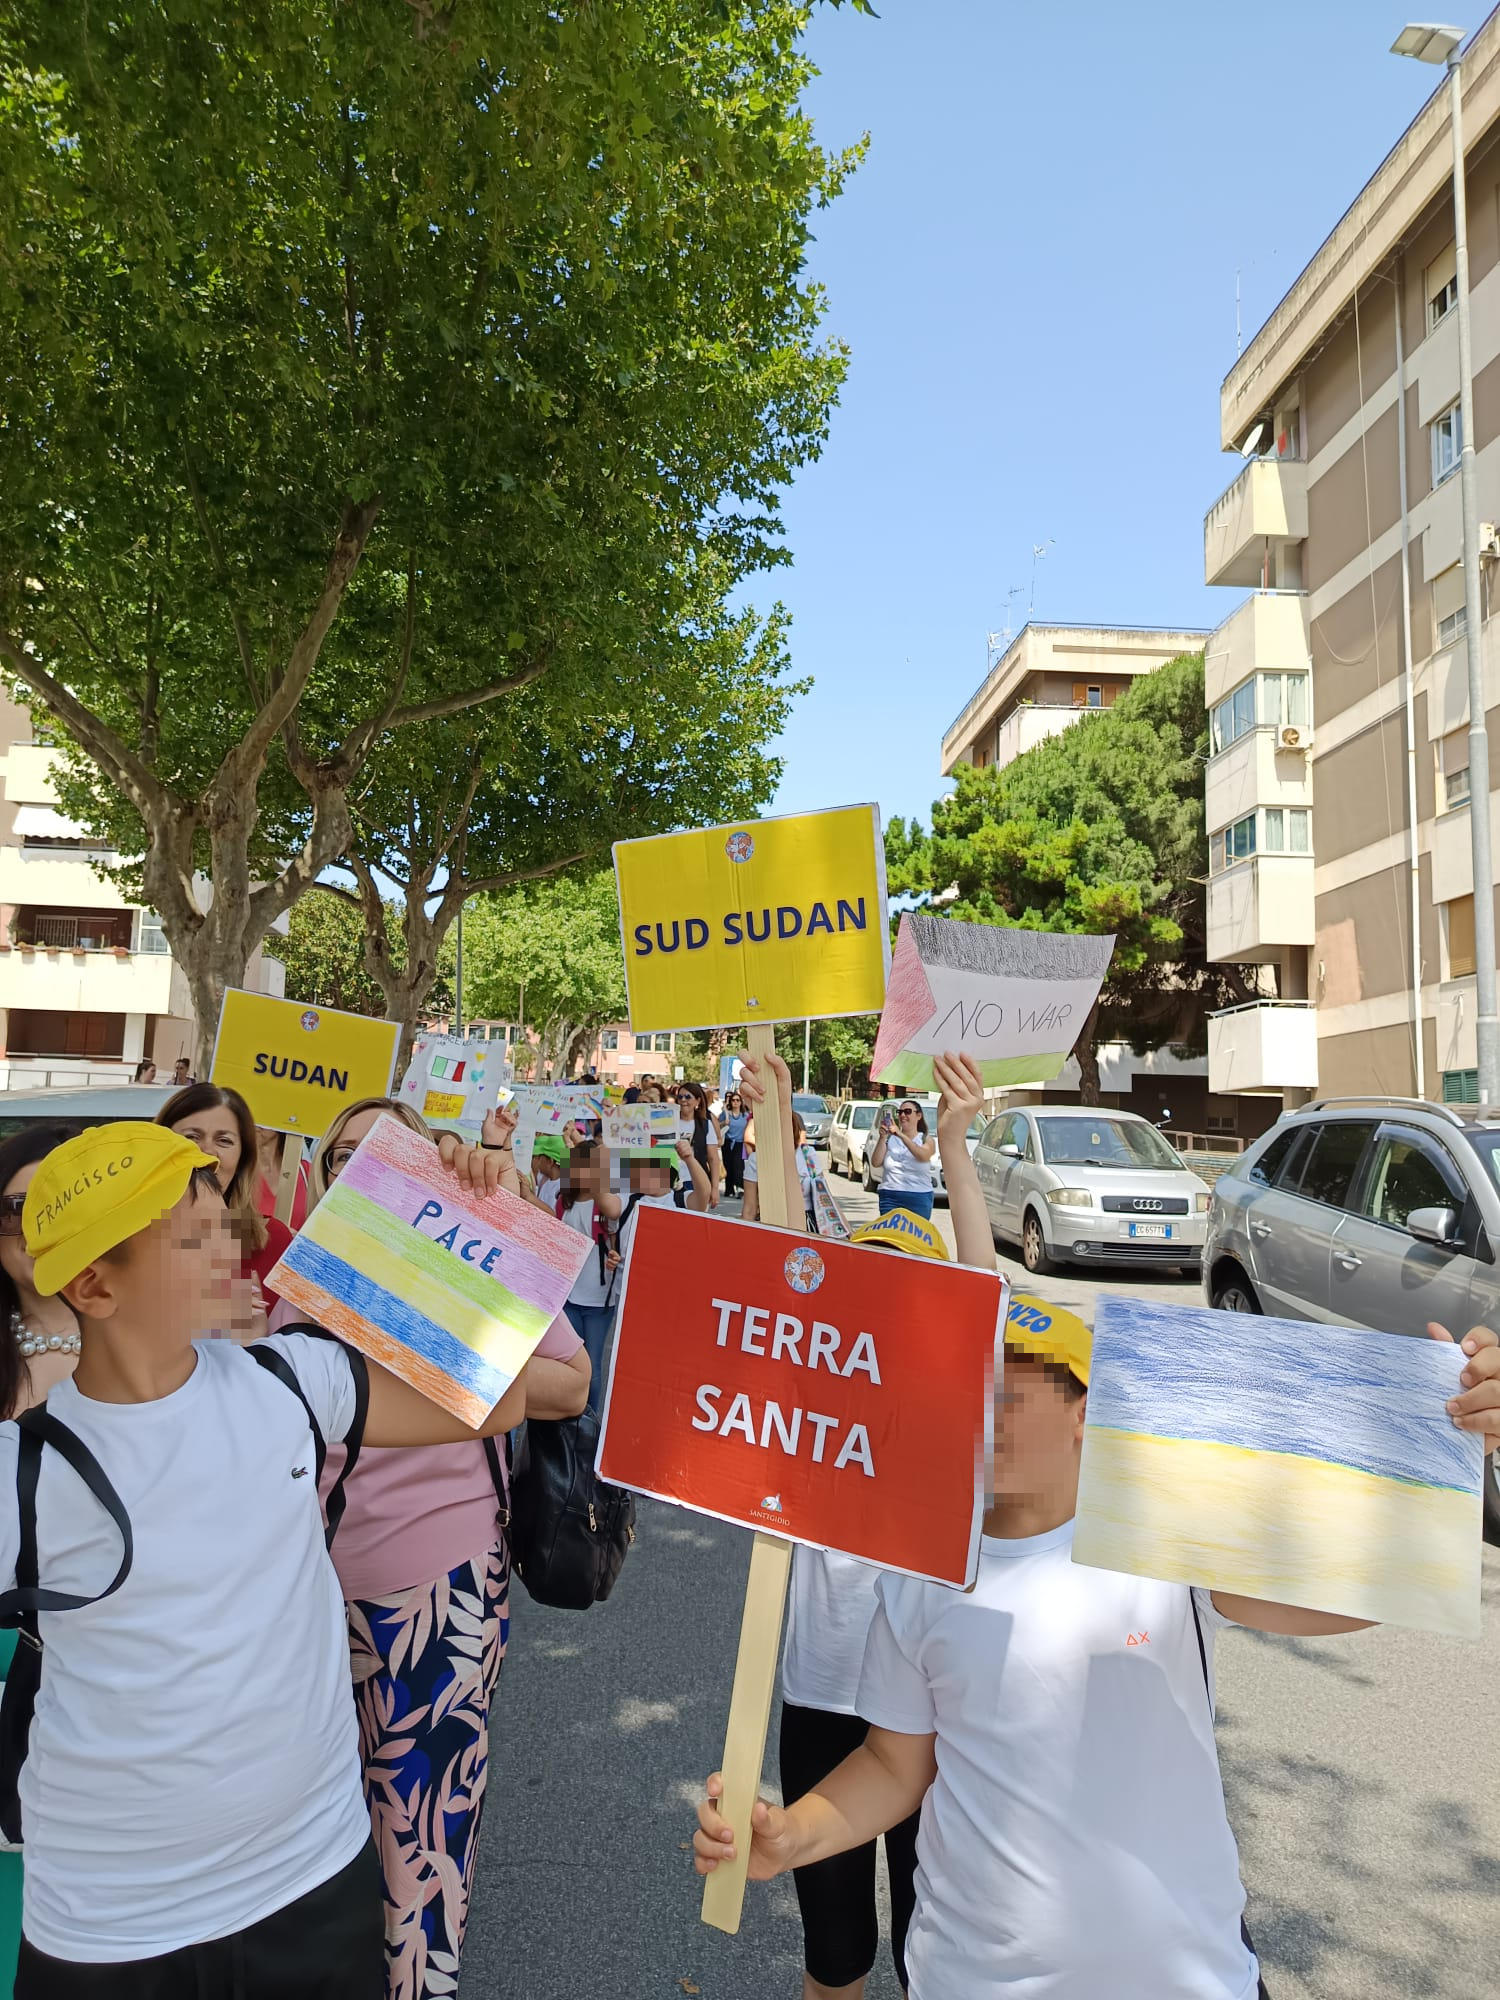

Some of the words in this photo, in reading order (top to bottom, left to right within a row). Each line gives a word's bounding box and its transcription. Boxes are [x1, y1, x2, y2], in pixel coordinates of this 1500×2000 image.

[633, 918, 710, 956] SUD
[723, 897, 867, 946] SUDAN
[932, 999, 1003, 1041] NO
[1017, 1002, 1073, 1033] WAR
[253, 1052, 349, 1092] SUDAN
[411, 1199, 503, 1274] PACE
[711, 1297, 882, 1386] TERRA
[691, 1384, 876, 1478] SANTA
